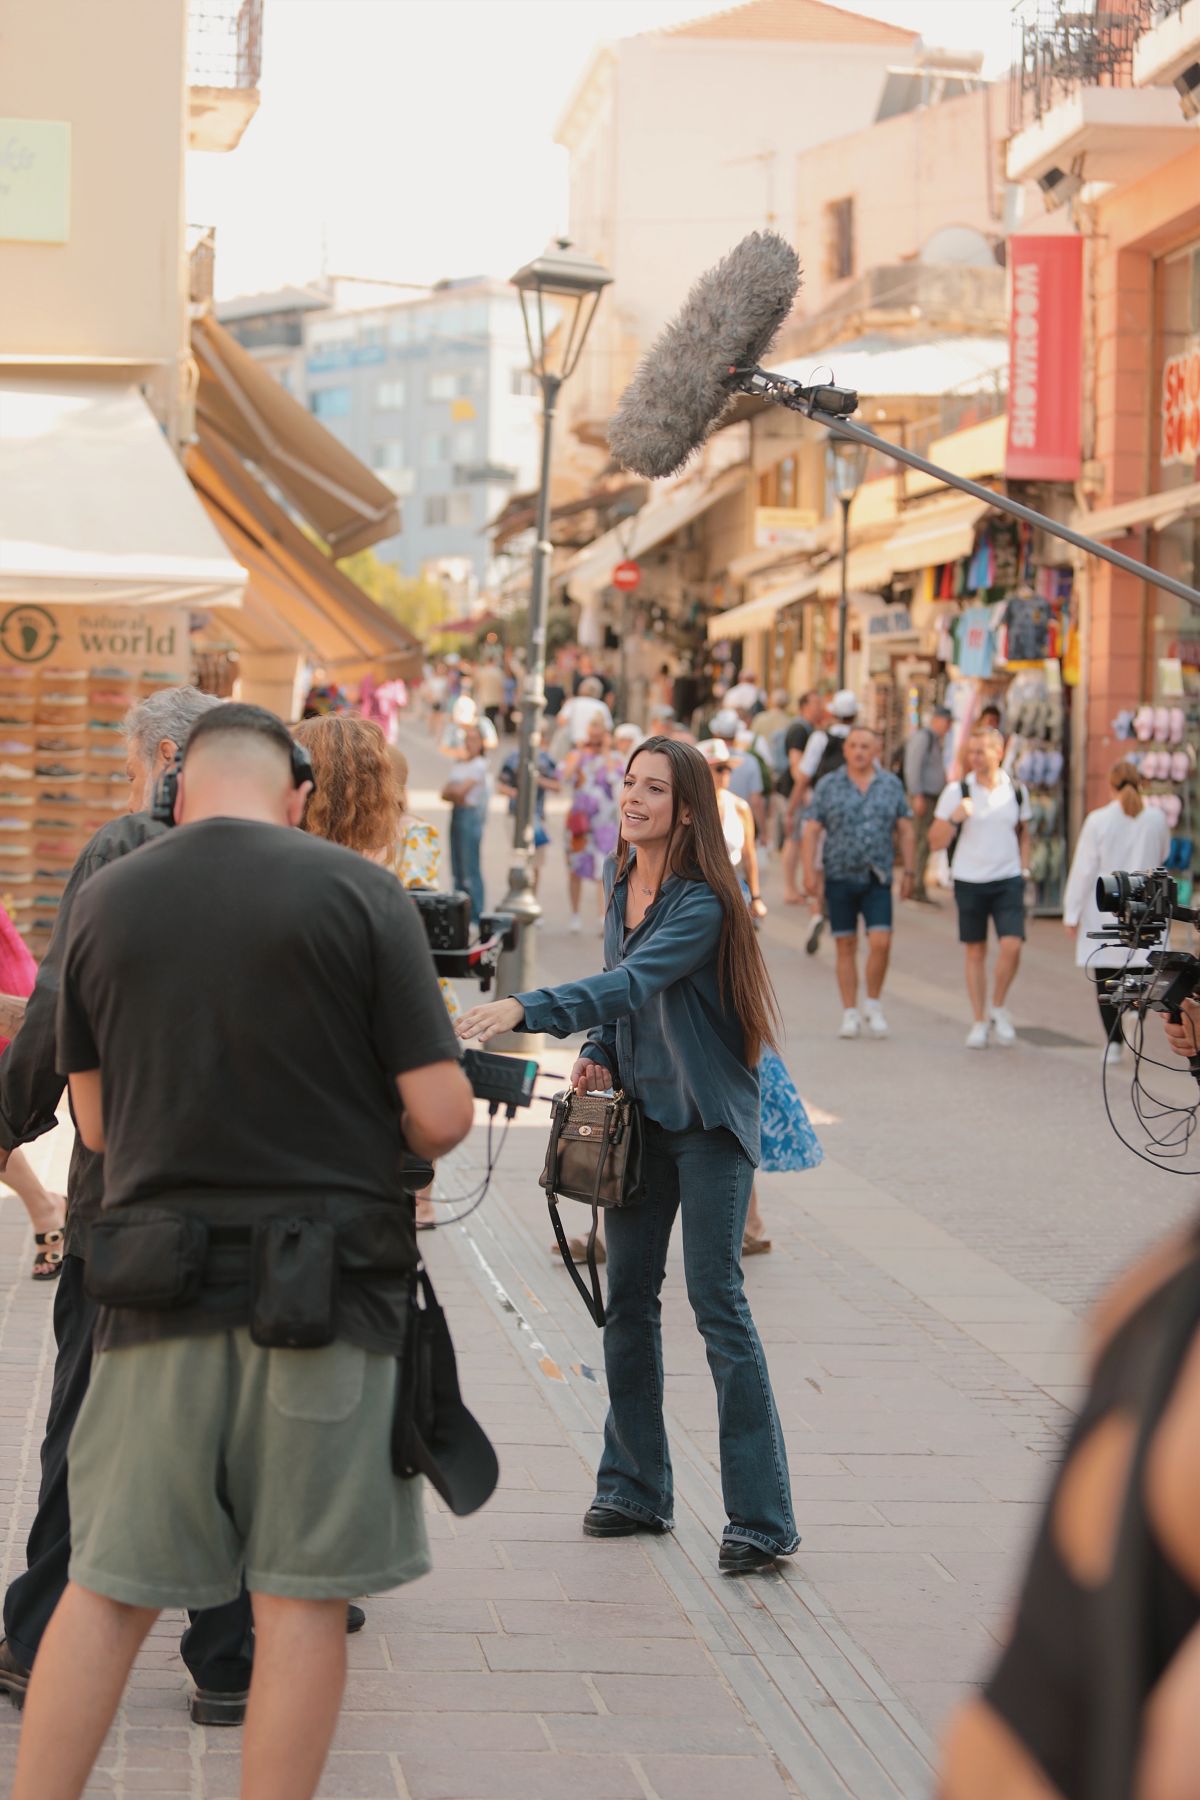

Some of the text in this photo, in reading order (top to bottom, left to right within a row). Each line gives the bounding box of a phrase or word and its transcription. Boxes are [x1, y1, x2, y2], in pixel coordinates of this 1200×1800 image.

[1011, 262, 1039, 448] SHOWROOM
[79, 613, 145, 630] natural
[80, 626, 175, 656] world
